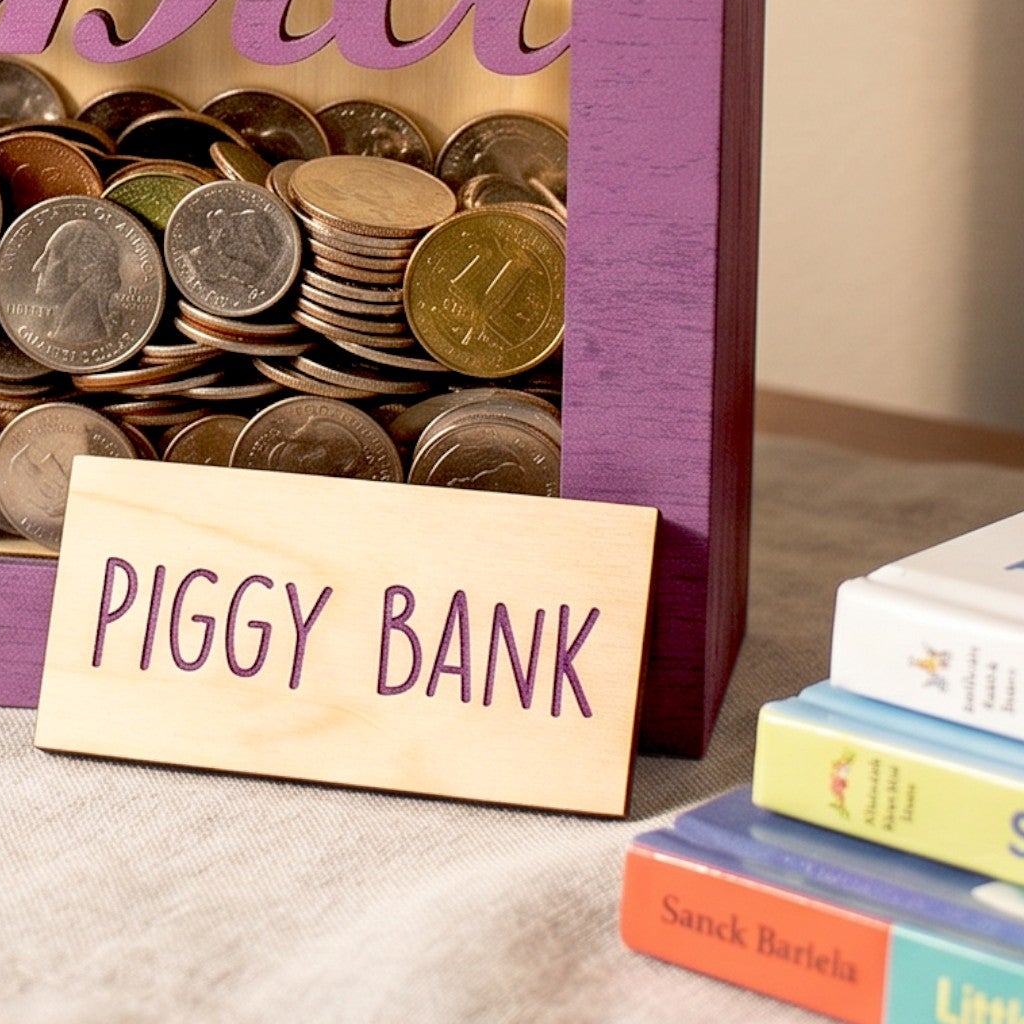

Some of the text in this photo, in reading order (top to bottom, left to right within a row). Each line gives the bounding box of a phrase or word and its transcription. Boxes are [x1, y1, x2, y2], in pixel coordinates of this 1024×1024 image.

[92, 556, 601, 719] PIGGY BANK
[660, 893, 747, 948] Sanck
